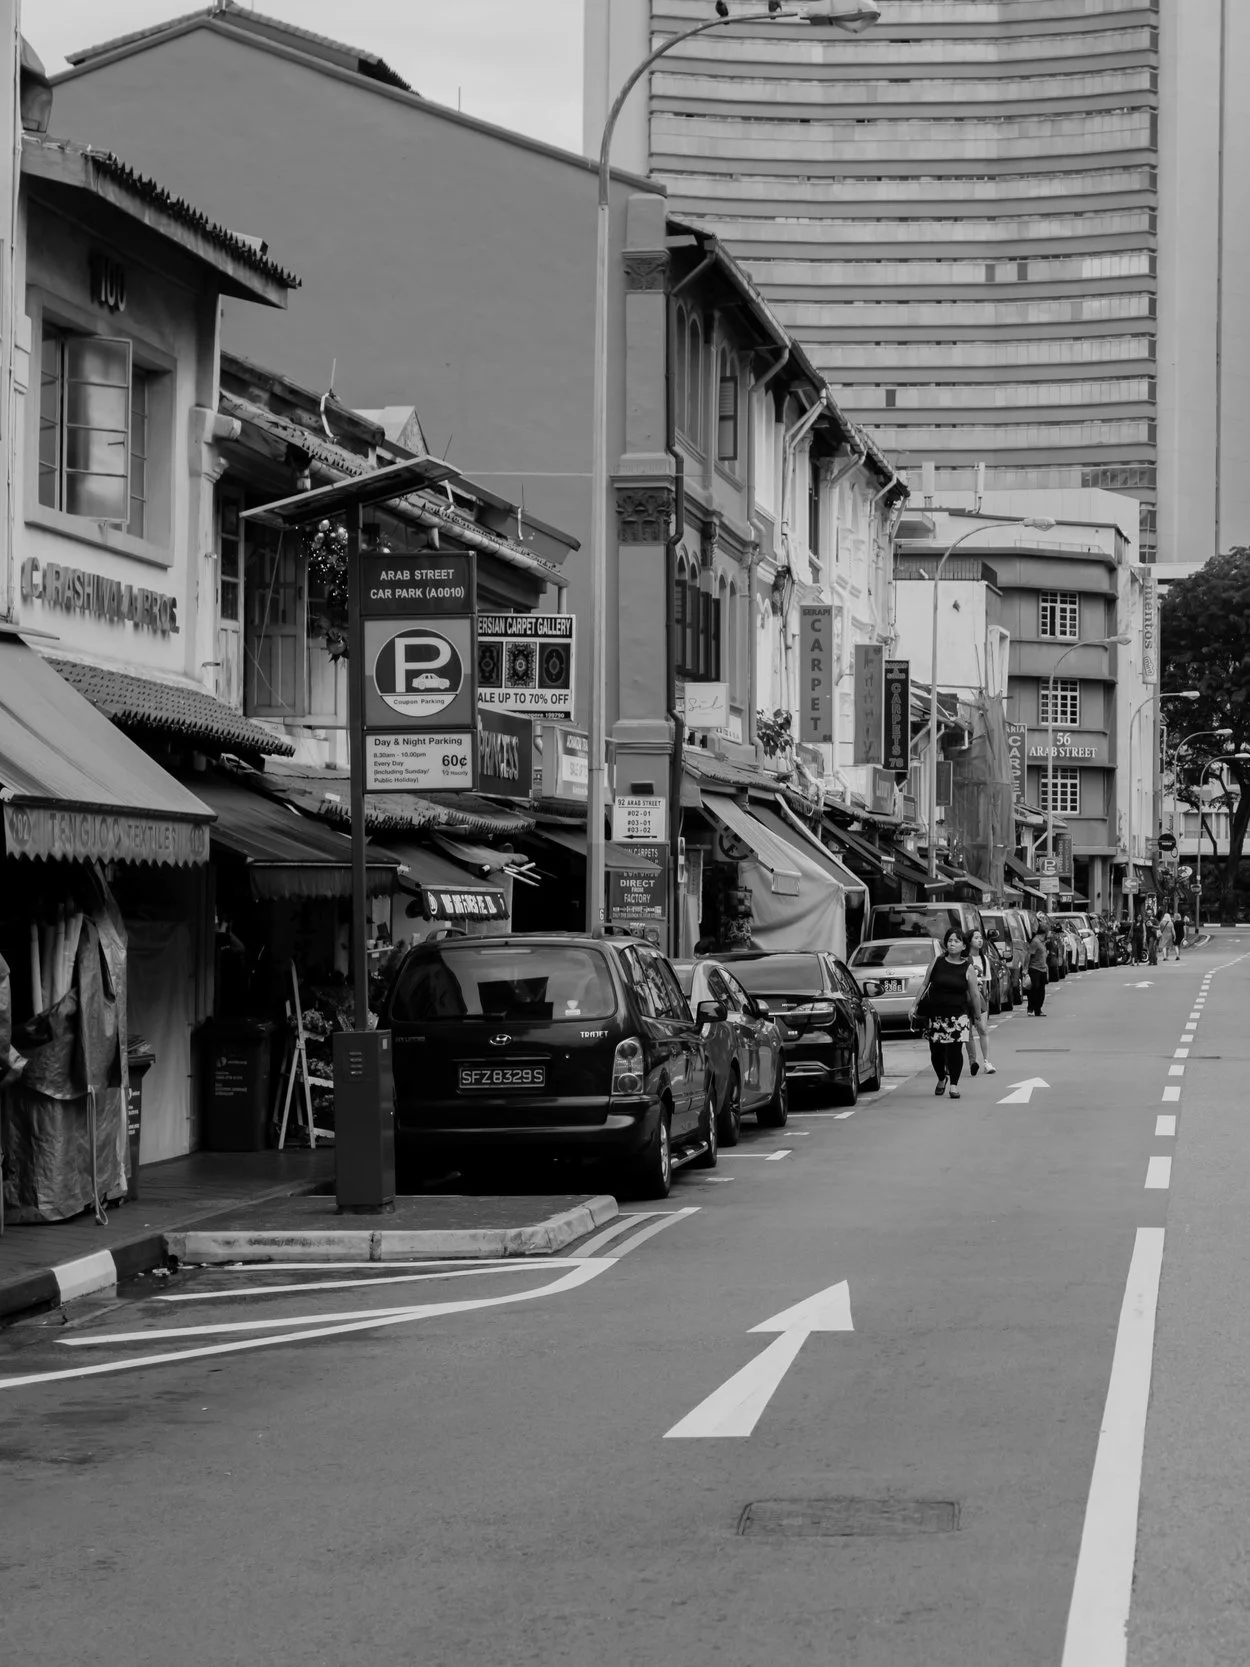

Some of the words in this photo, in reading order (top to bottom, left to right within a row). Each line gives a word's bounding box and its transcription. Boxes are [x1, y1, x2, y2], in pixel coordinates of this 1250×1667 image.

[380, 570, 410, 580] ARAB
[414, 569, 454, 580] STREET
[370, 589, 392, 599] CAR
[395, 588, 423, 598] PARK
[426, 586, 464, 599] (A0010)
[803, 608, 831, 616] SERAPI
[478, 617, 505, 634] ERSIAN
[507, 618, 536, 634] CARPET
[537, 618, 571, 635] GALLERY
[810, 619, 823, 731] CARPET
[478, 692, 495, 703] ALE
[498, 693, 511, 703] UP
[513, 693, 526, 704] TO
[529, 693, 548, 704] 70%
[551, 693, 569, 704] OFF
[891, 683, 901, 755] CARPETS
[374, 738, 391, 747] Day
[402, 738, 426, 747] Night
[429, 737, 462, 746] Parking
[1056, 733, 1071, 745] 56
[1029, 746, 1057, 757] ARAB
[1059, 747, 1097, 758] STREET
[442, 754, 468, 769] 60¢
[127, 825, 176, 850] TEXTILES
[620, 879, 655, 887] DIRECT
[624, 893, 651, 903] FACTORY
